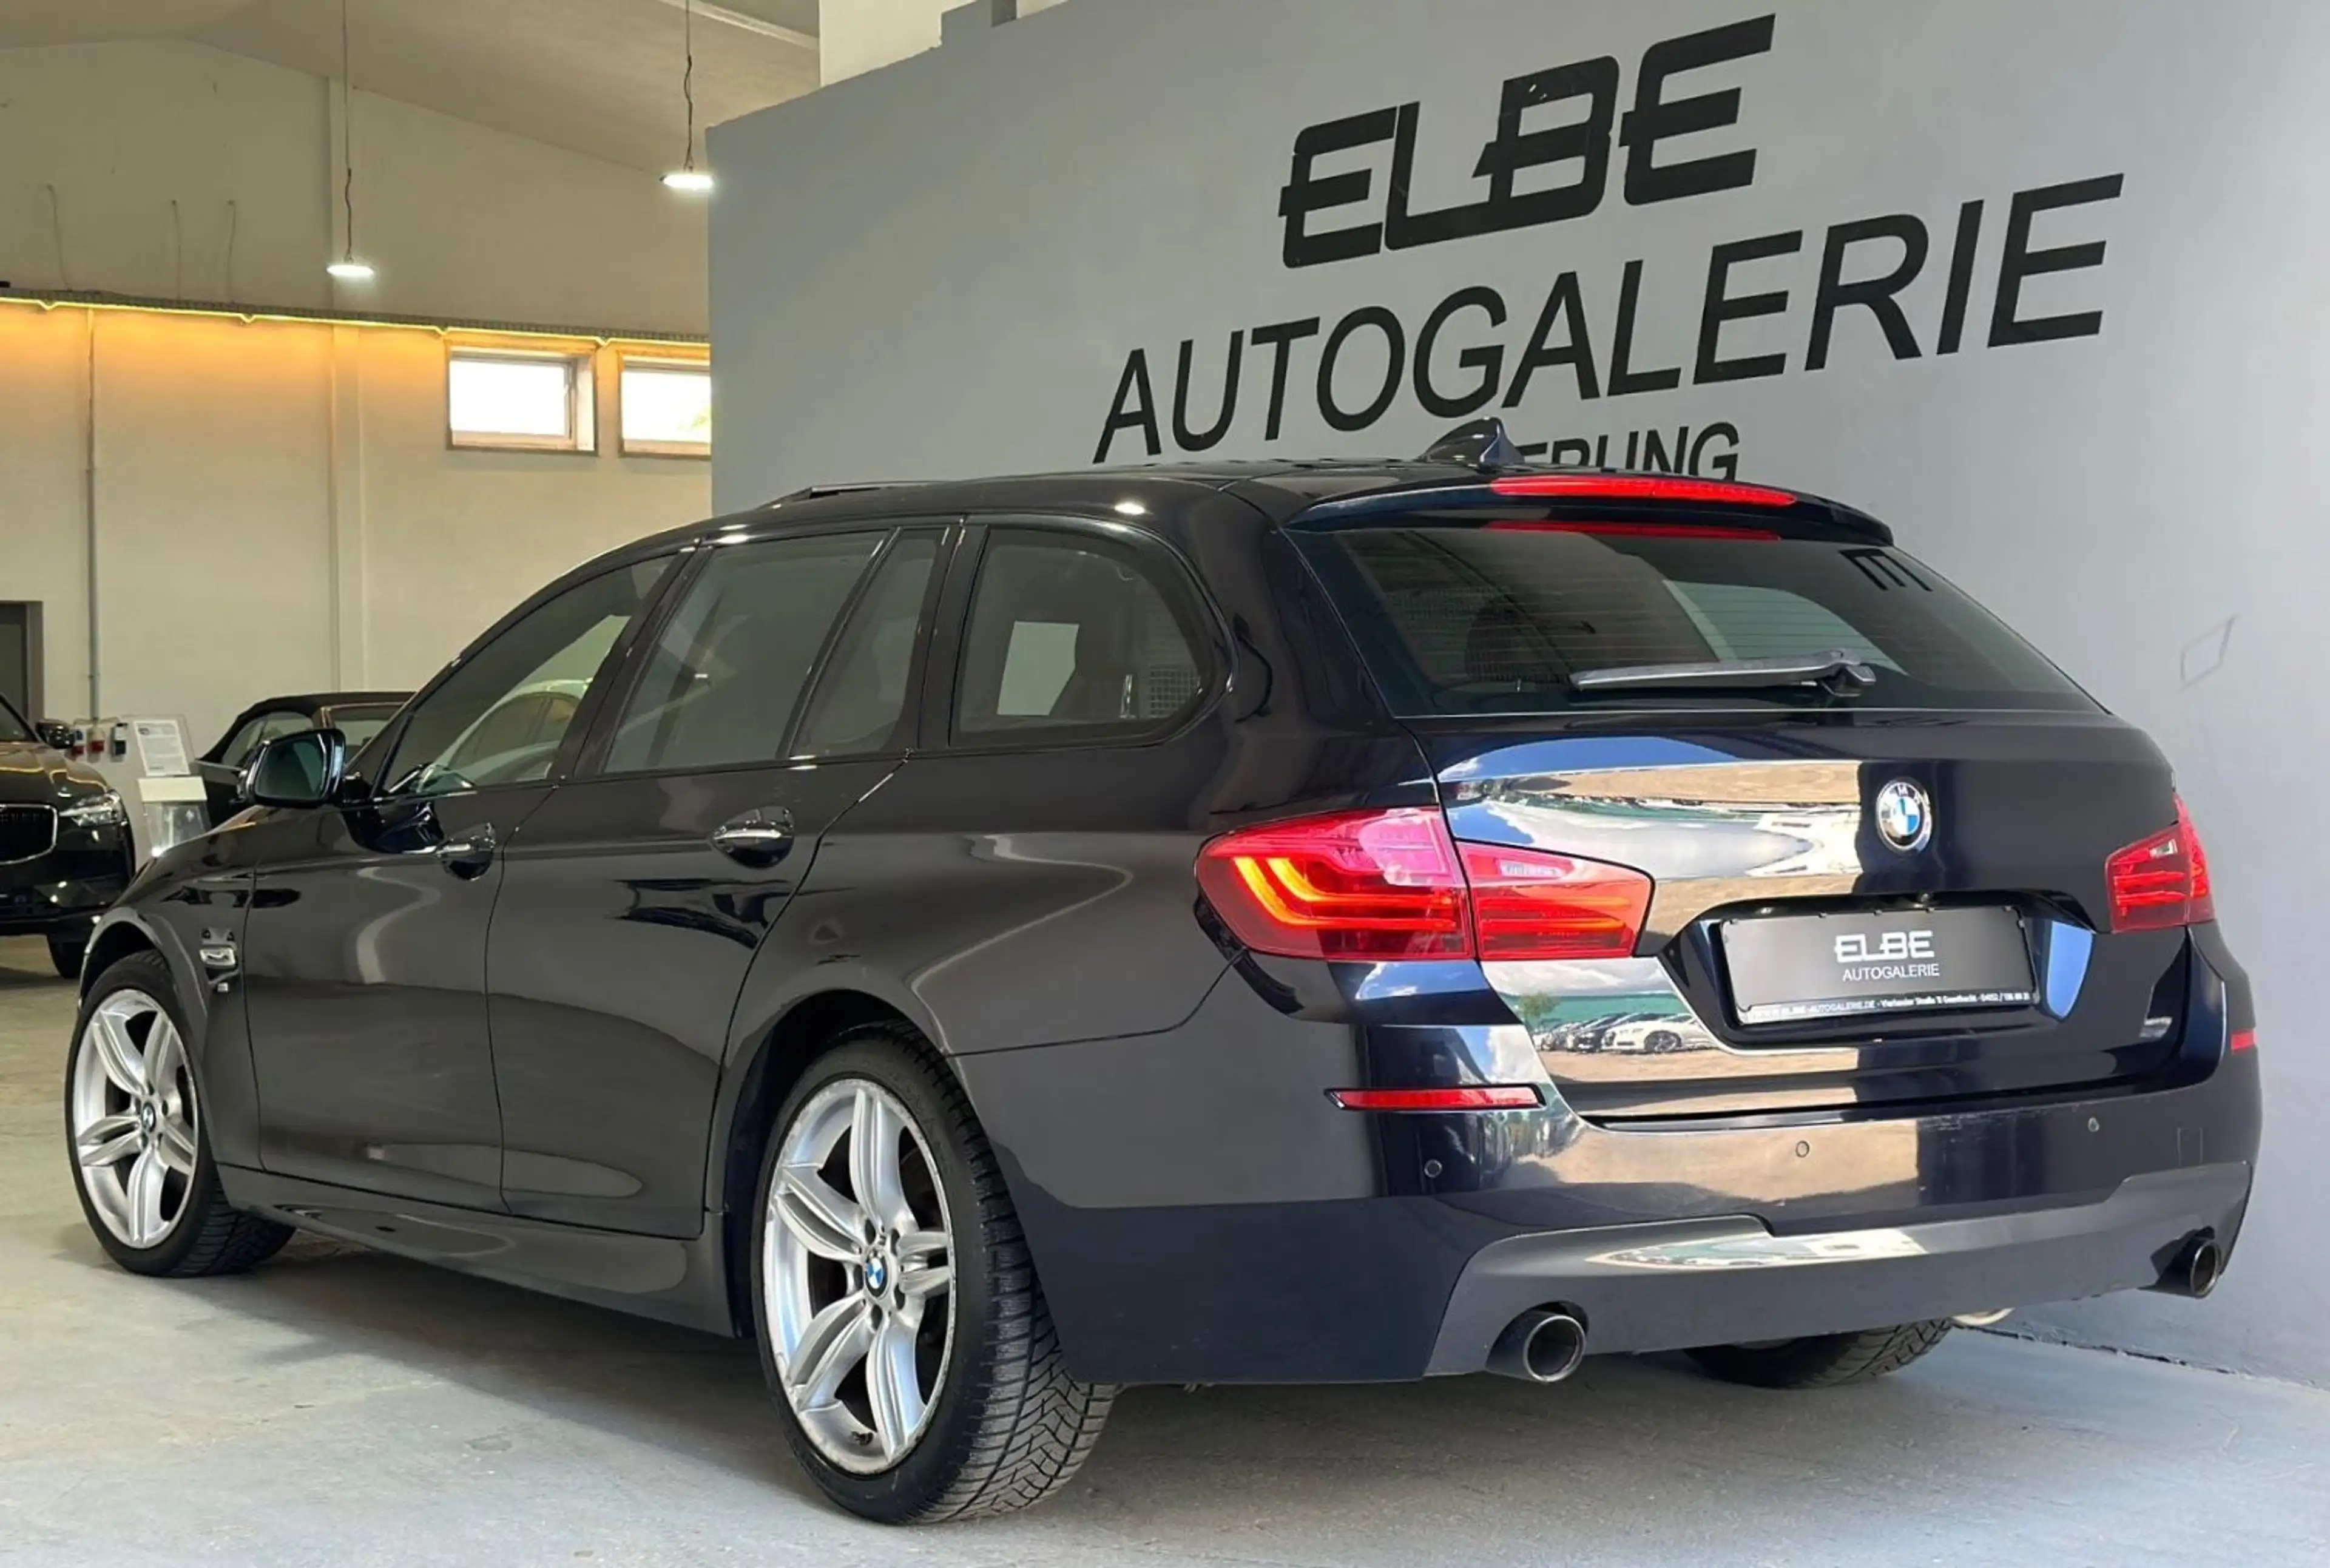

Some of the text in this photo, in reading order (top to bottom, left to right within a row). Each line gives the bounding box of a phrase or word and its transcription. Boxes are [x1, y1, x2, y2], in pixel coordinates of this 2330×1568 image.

[1278, 13, 1775, 268] ELBE
[1093, 174, 2124, 464] AUTOGALERIE
[1834, 930, 1935, 963] ELBE
[1842, 964, 1940, 982] AUTOGALERIE
